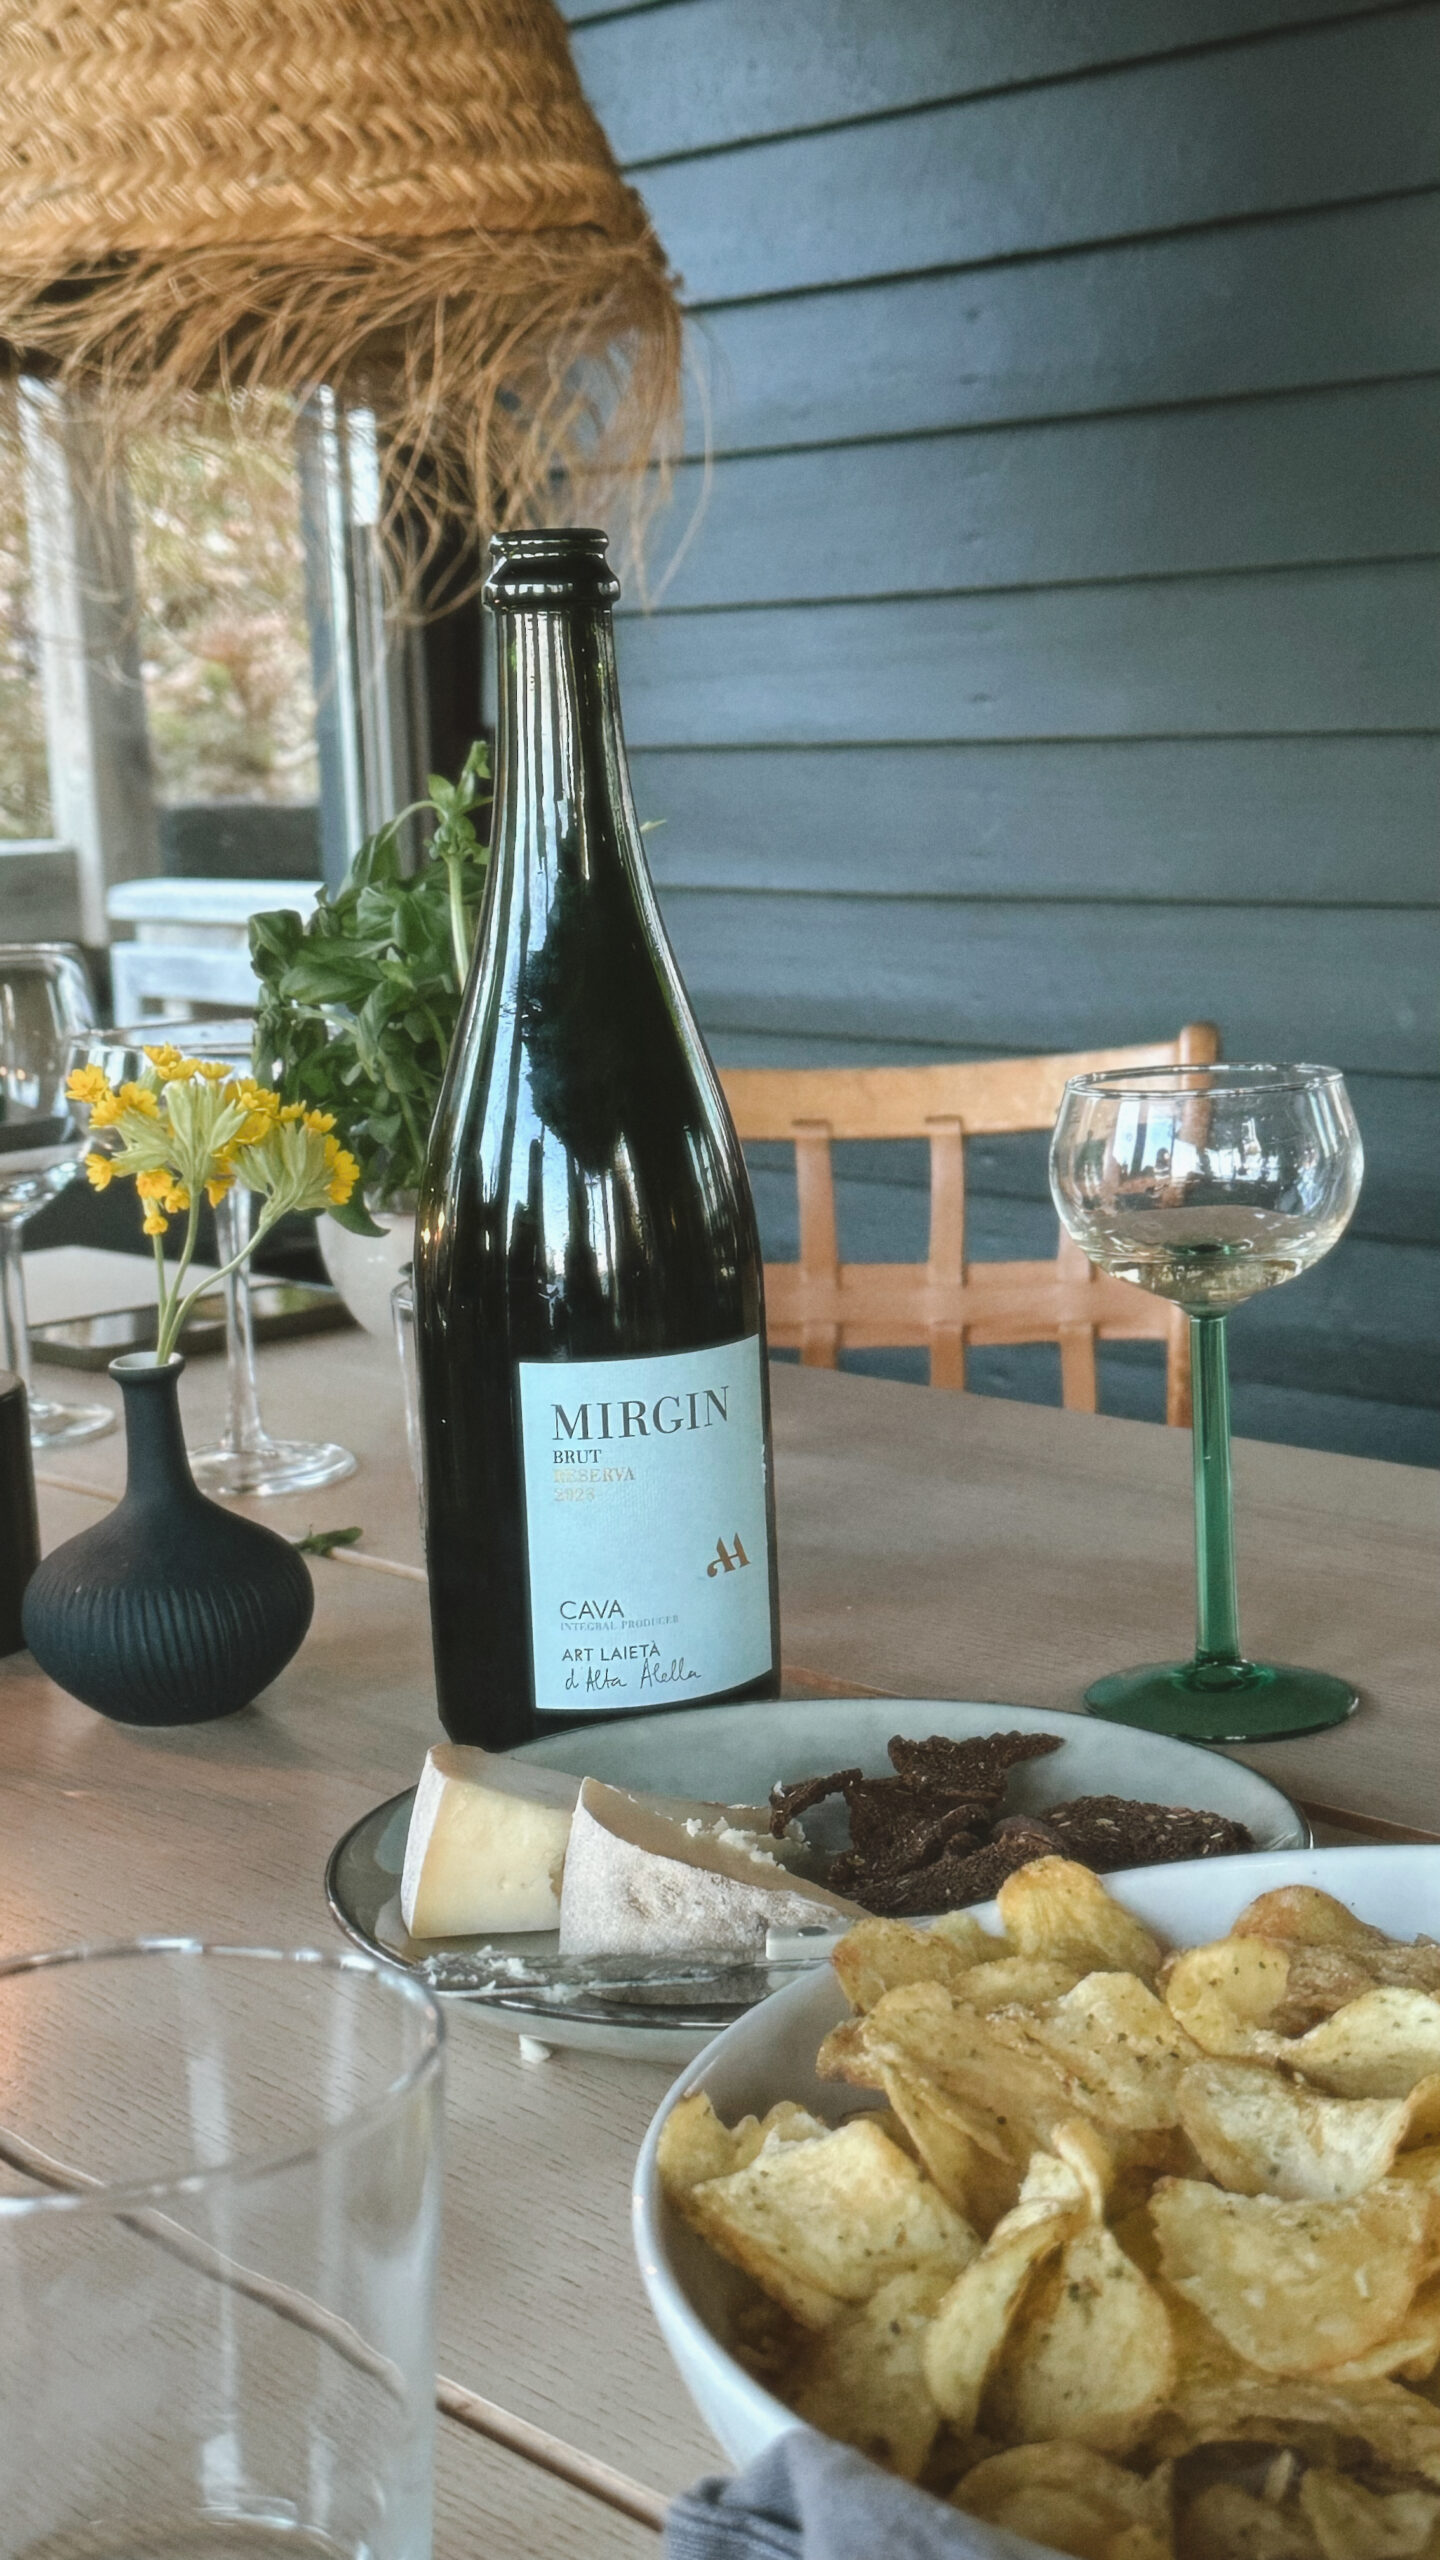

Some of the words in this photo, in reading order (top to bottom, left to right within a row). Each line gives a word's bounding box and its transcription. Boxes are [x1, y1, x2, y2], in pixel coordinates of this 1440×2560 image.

[551, 1386, 729, 1440] MIRGIN
[553, 1449, 602, 1464] BRUT
[553, 1466, 636, 1483] RESERVA
[560, 1599, 624, 1620] CAVA
[560, 1621, 617, 1631] INTEGRAL
[621, 1615, 679, 1629] PRODUCER
[562, 1648, 594, 1661] ART
[600, 1640, 661, 1661] LAIETÀ
[640, 1657, 702, 1689] Alella
